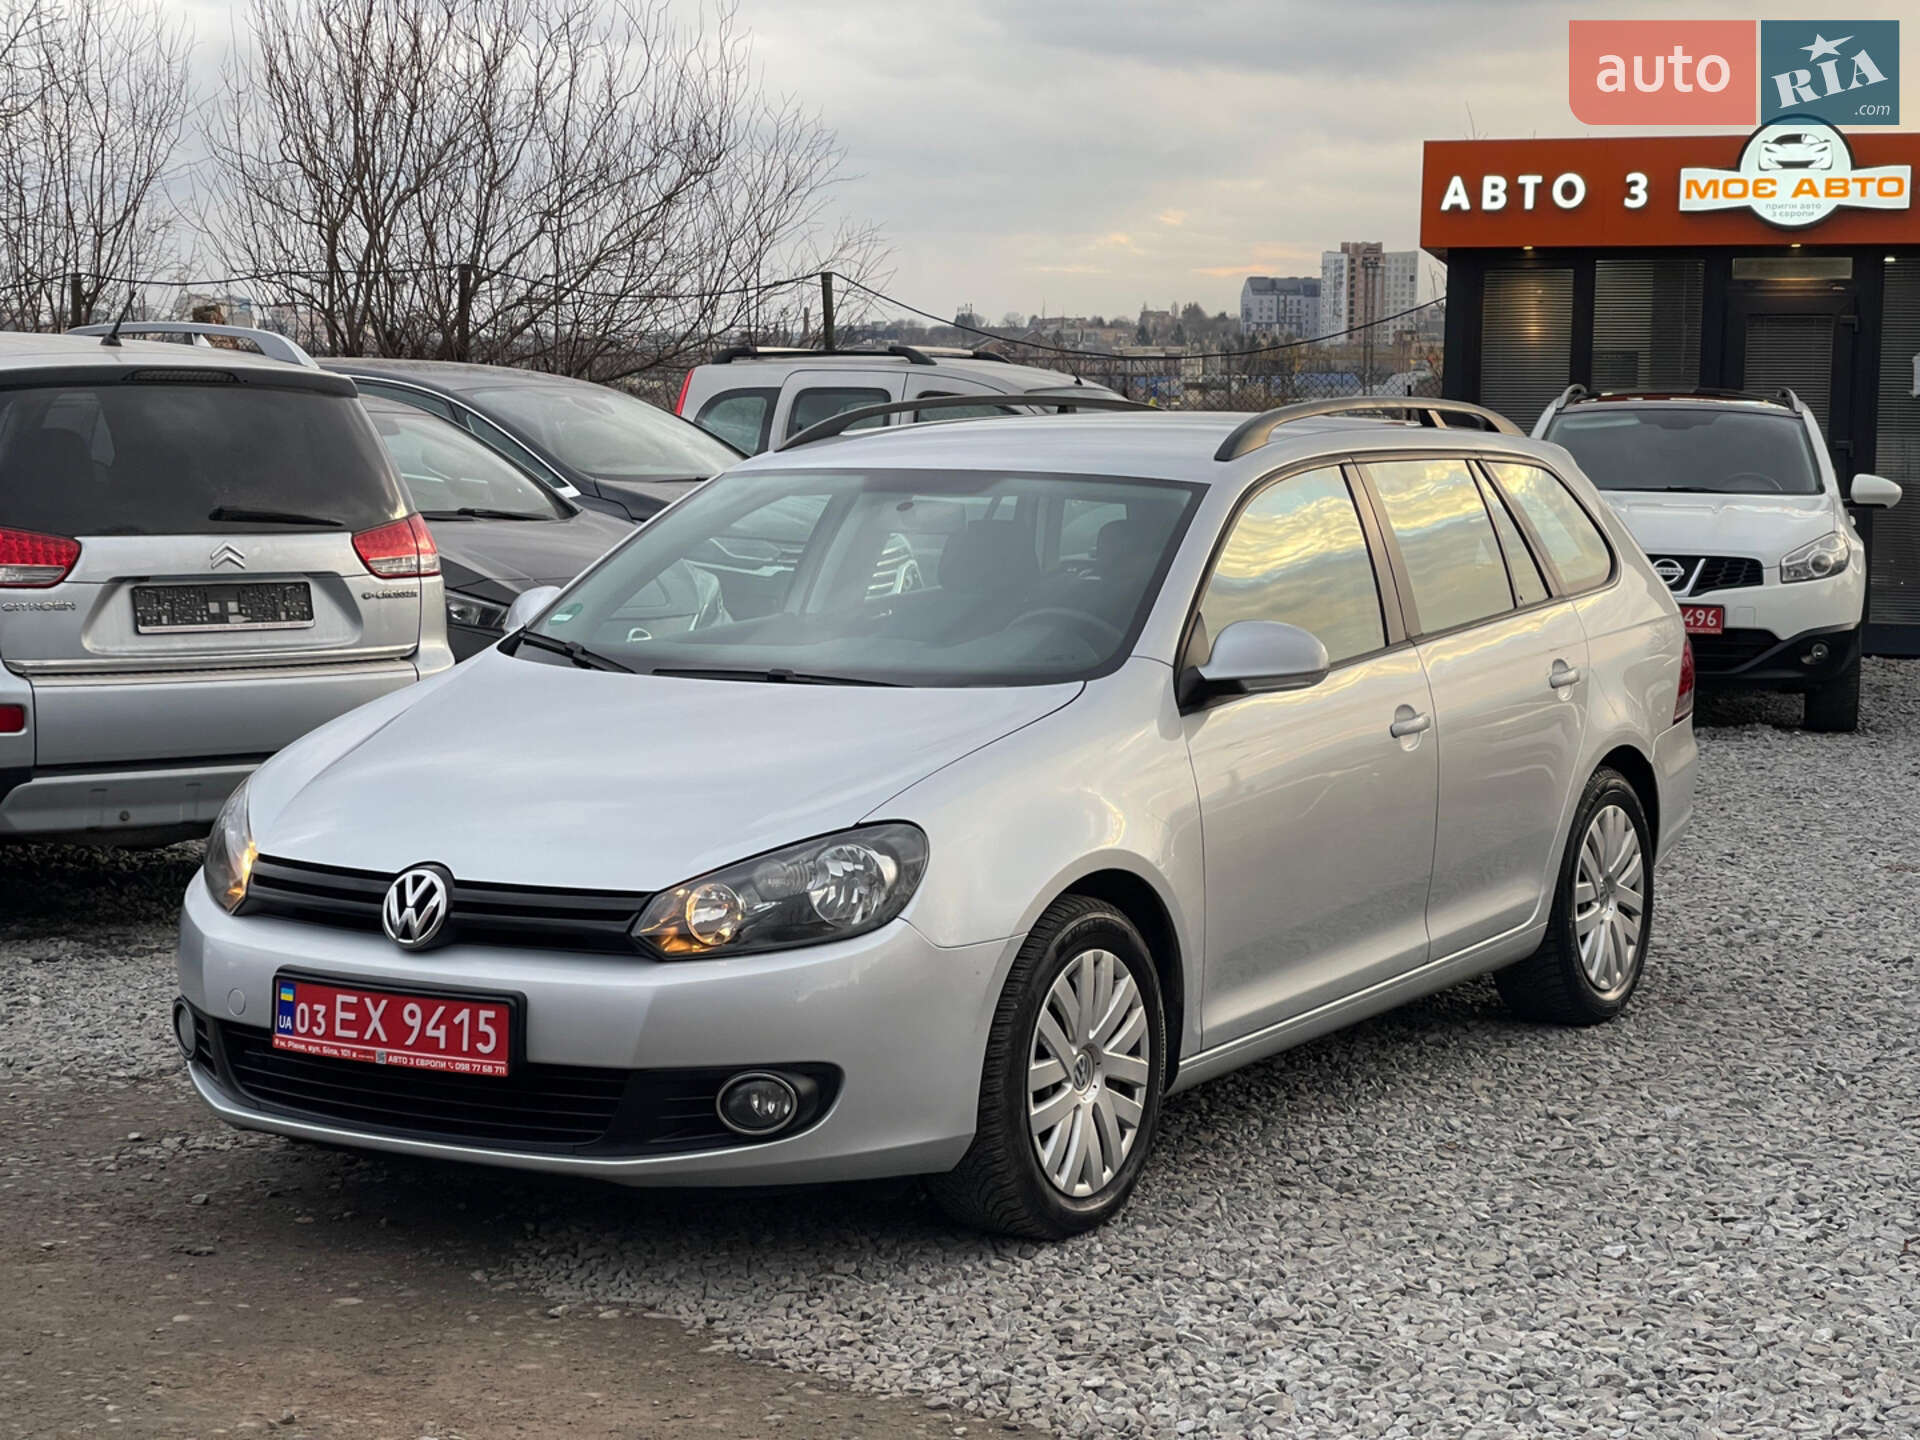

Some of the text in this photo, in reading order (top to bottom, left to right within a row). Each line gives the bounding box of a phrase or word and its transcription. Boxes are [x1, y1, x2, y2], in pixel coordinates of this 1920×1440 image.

[1440, 172, 1587, 211] АВТО
[1685, 177, 1905, 199] МОЄ АВТО
[279, 1015, 292, 1030] UA
[296, 994, 497, 1054] 03 EX 9415
[388, 1055, 408, 1065] АВТО
